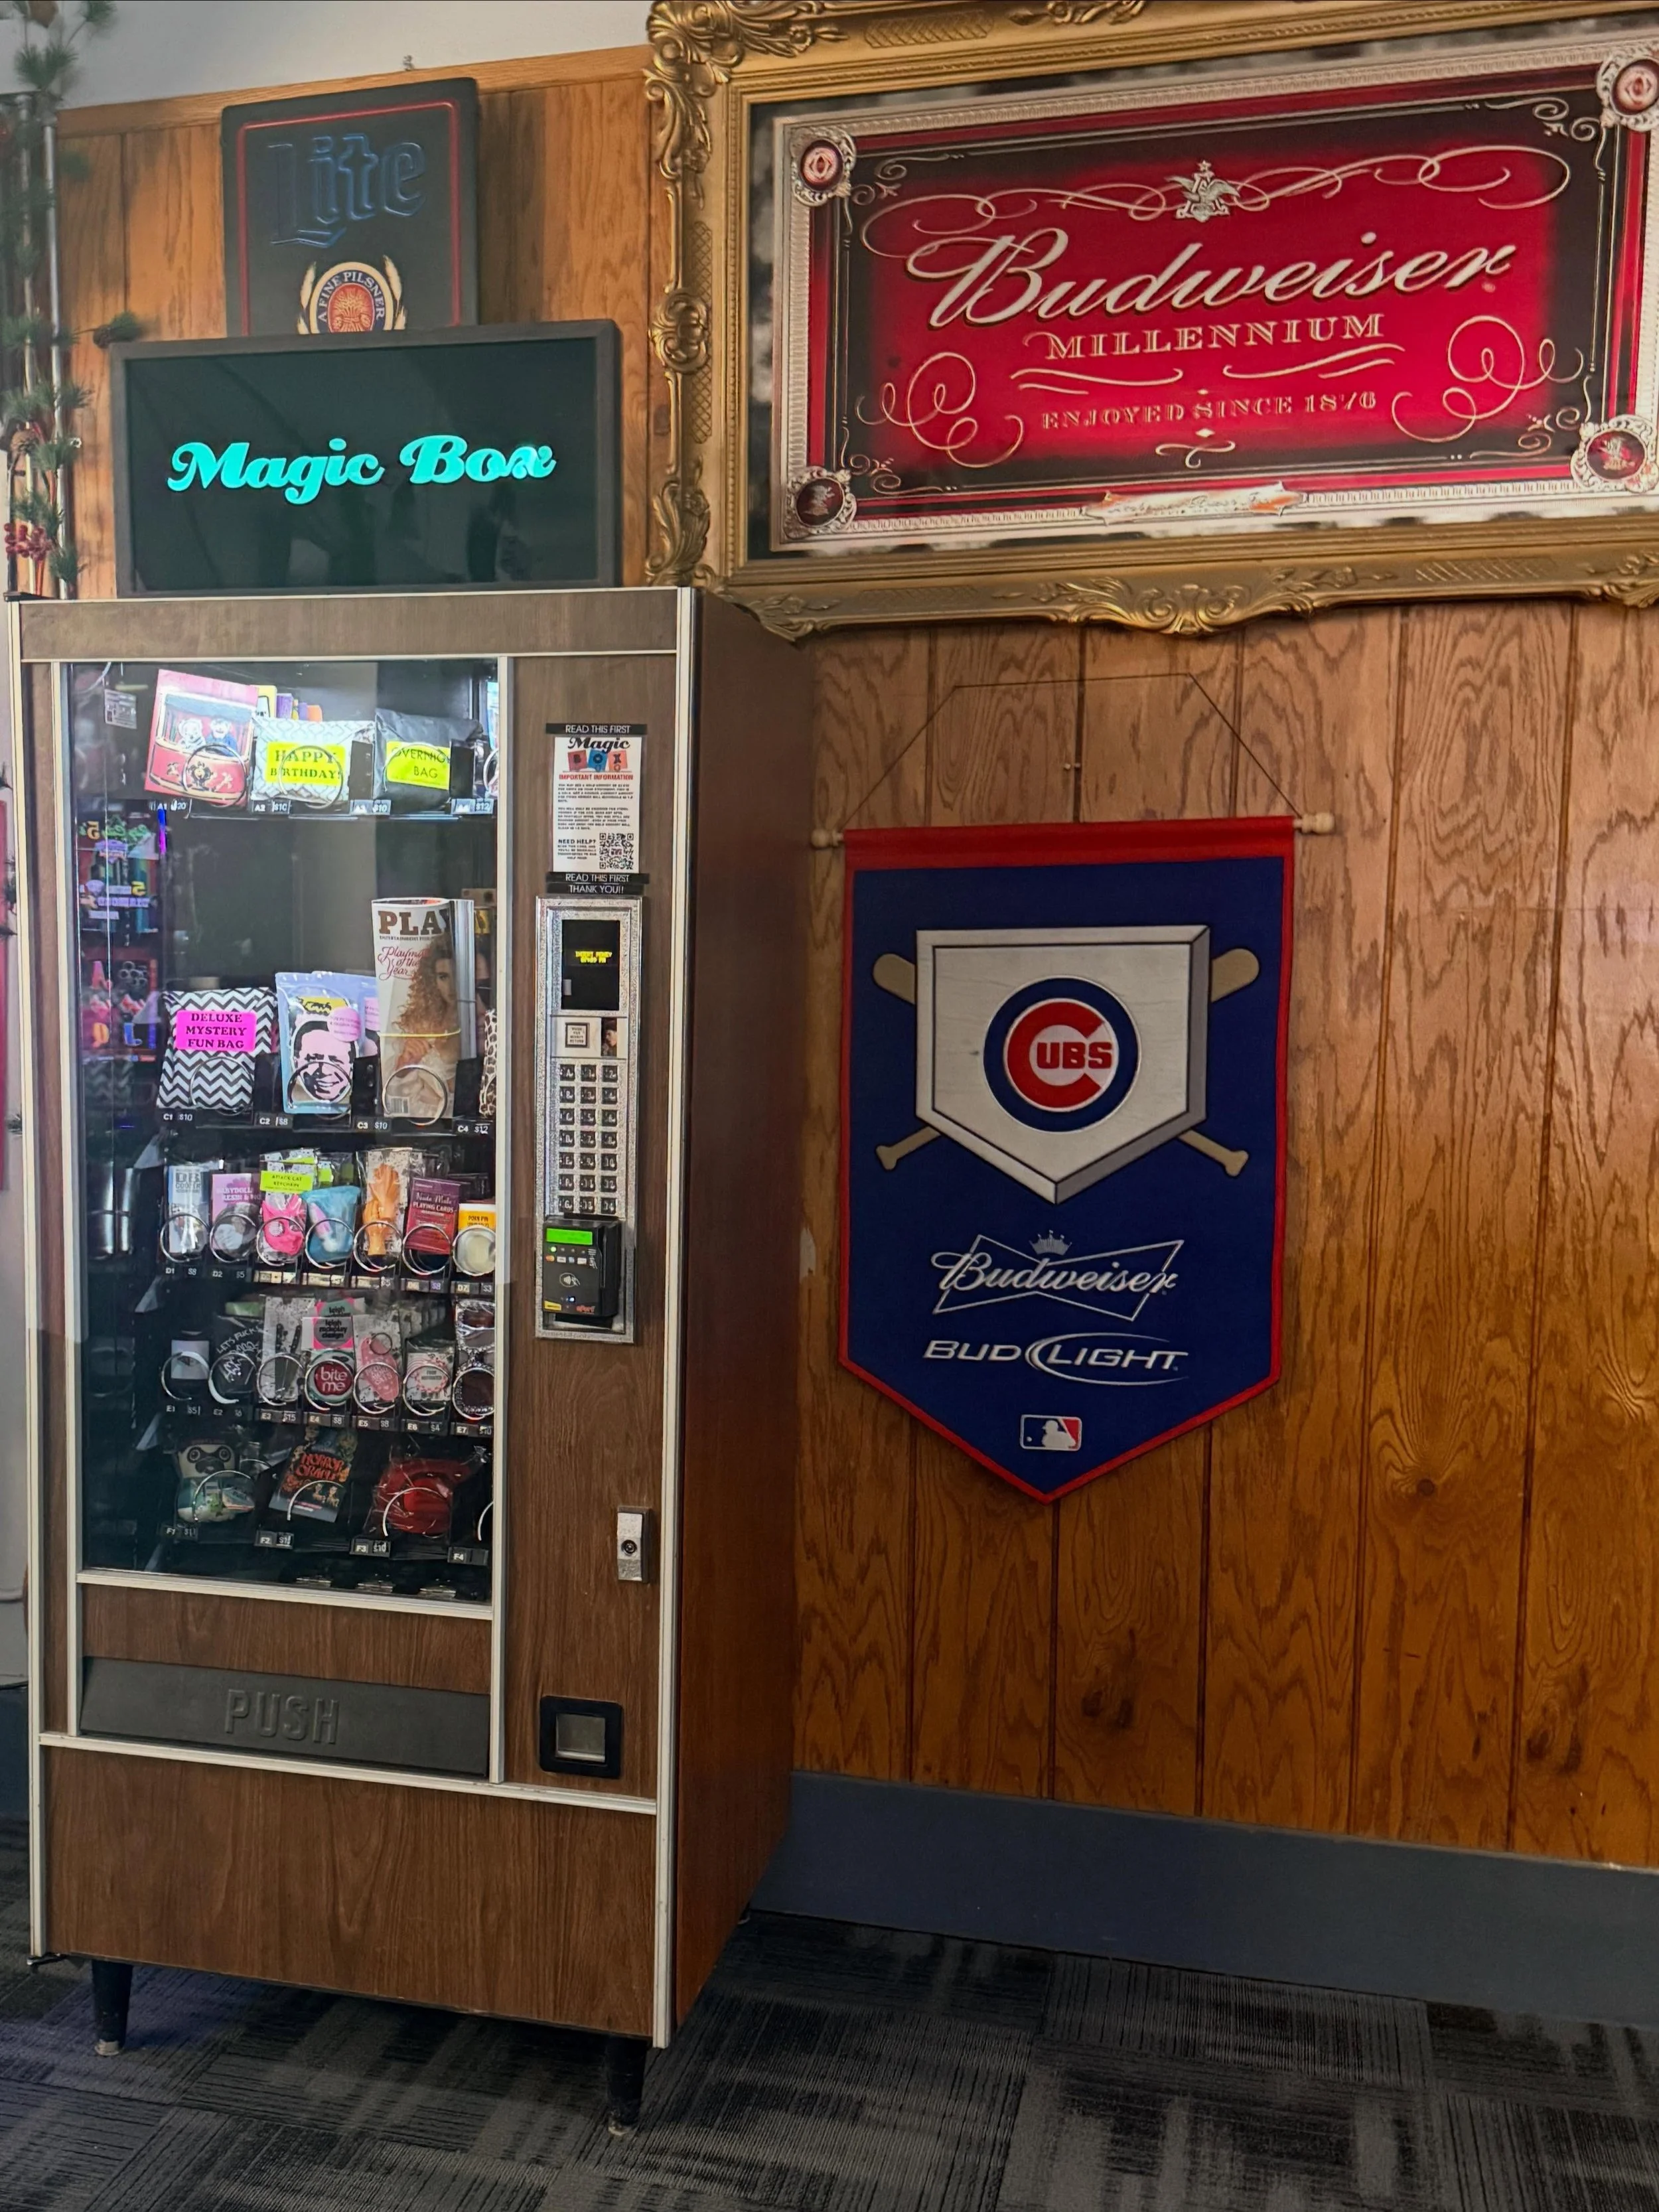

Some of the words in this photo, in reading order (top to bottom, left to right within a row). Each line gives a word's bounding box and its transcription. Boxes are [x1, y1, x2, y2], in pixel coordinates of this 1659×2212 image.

[268, 133, 426, 248] Lite
[905, 228, 1516, 329] Budweiser
[319, 275, 342, 308] FINE
[343, 271, 385, 321] PILSNER
[318, 314, 327, 323] A
[1023, 313, 1385, 360] MILLENNIUM
[1043, 404, 1184, 429] ENJOYED
[1195, 396, 1292, 419] SINCE
[1305, 391, 1376, 413] 1876
[167, 438, 385, 505] Magic
[399, 434, 557, 485] Box
[565, 725, 589, 733] READ
[591, 725, 608, 733] THIS
[610, 725, 631, 733] FIRST
[567, 737, 630, 754] Magic
[275, 750, 336, 763] HAPPY
[392, 747, 449, 764] OVERNIG
[414, 766, 438, 778] BAG
[569, 885, 597, 893] THANK
[600, 885, 624, 894] YOU!!
[190, 1013, 242, 1023] DELUXE
[186, 1026, 247, 1036] MYSTERY
[218, 1040, 244, 1049] BAG
[1007, 1001, 1112, 1108] CUBS
[413, 1201, 435, 1210] PLAYING
[437, 1205, 453, 1213] CARDS
[931, 1252, 1179, 1293] Budweiser
[216, 1337, 236, 1353] LET'S
[234, 1328, 255, 1340] FUCK
[924, 1340, 1022, 1361] BUD
[1046, 1344, 1189, 1369] LIGHT
[321, 1367, 347, 1381] bite
[323, 1382, 346, 1391] me
[225, 1689, 340, 1744] PUSH
